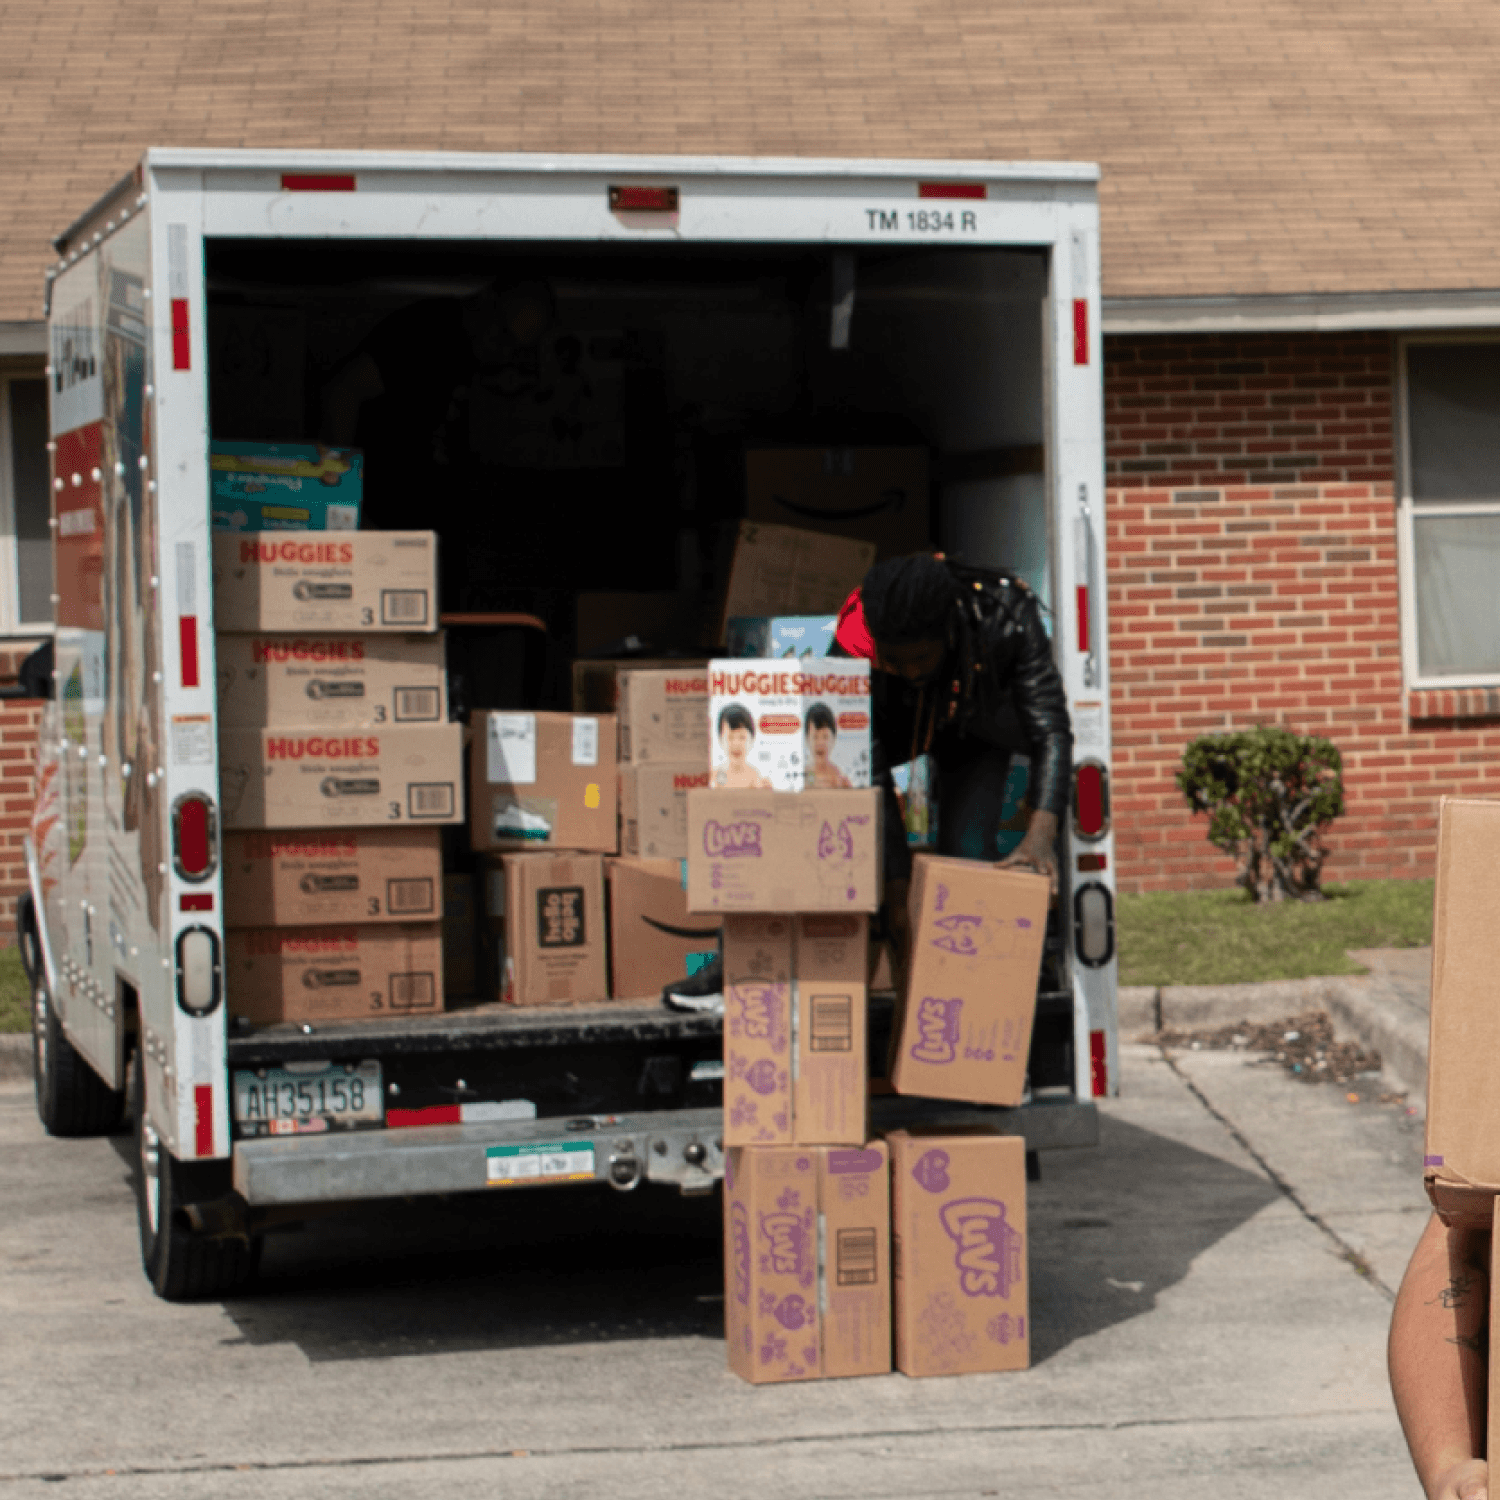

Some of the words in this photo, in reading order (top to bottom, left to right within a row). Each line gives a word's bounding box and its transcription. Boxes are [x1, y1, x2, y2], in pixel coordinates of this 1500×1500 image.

[865, 208, 899, 232] TM
[907, 209, 955, 233] 1834
[961, 209, 978, 232] R
[239, 540, 354, 565] HUGGIES
[362, 606, 374, 627] 3
[253, 639, 366, 664] HUGGIES
[712, 671, 802, 696] HUGGIES
[801, 674, 871, 697] HUGGIES
[374, 703, 387, 723] 3
[266, 736, 381, 761] HUGGIES
[388, 801, 402, 820] 3
[368, 896, 380, 916] 3
[369, 990, 383, 1010] 3
[247, 1078, 364, 1119] AH35158
[943, 1202, 1003, 1297] Luvs
